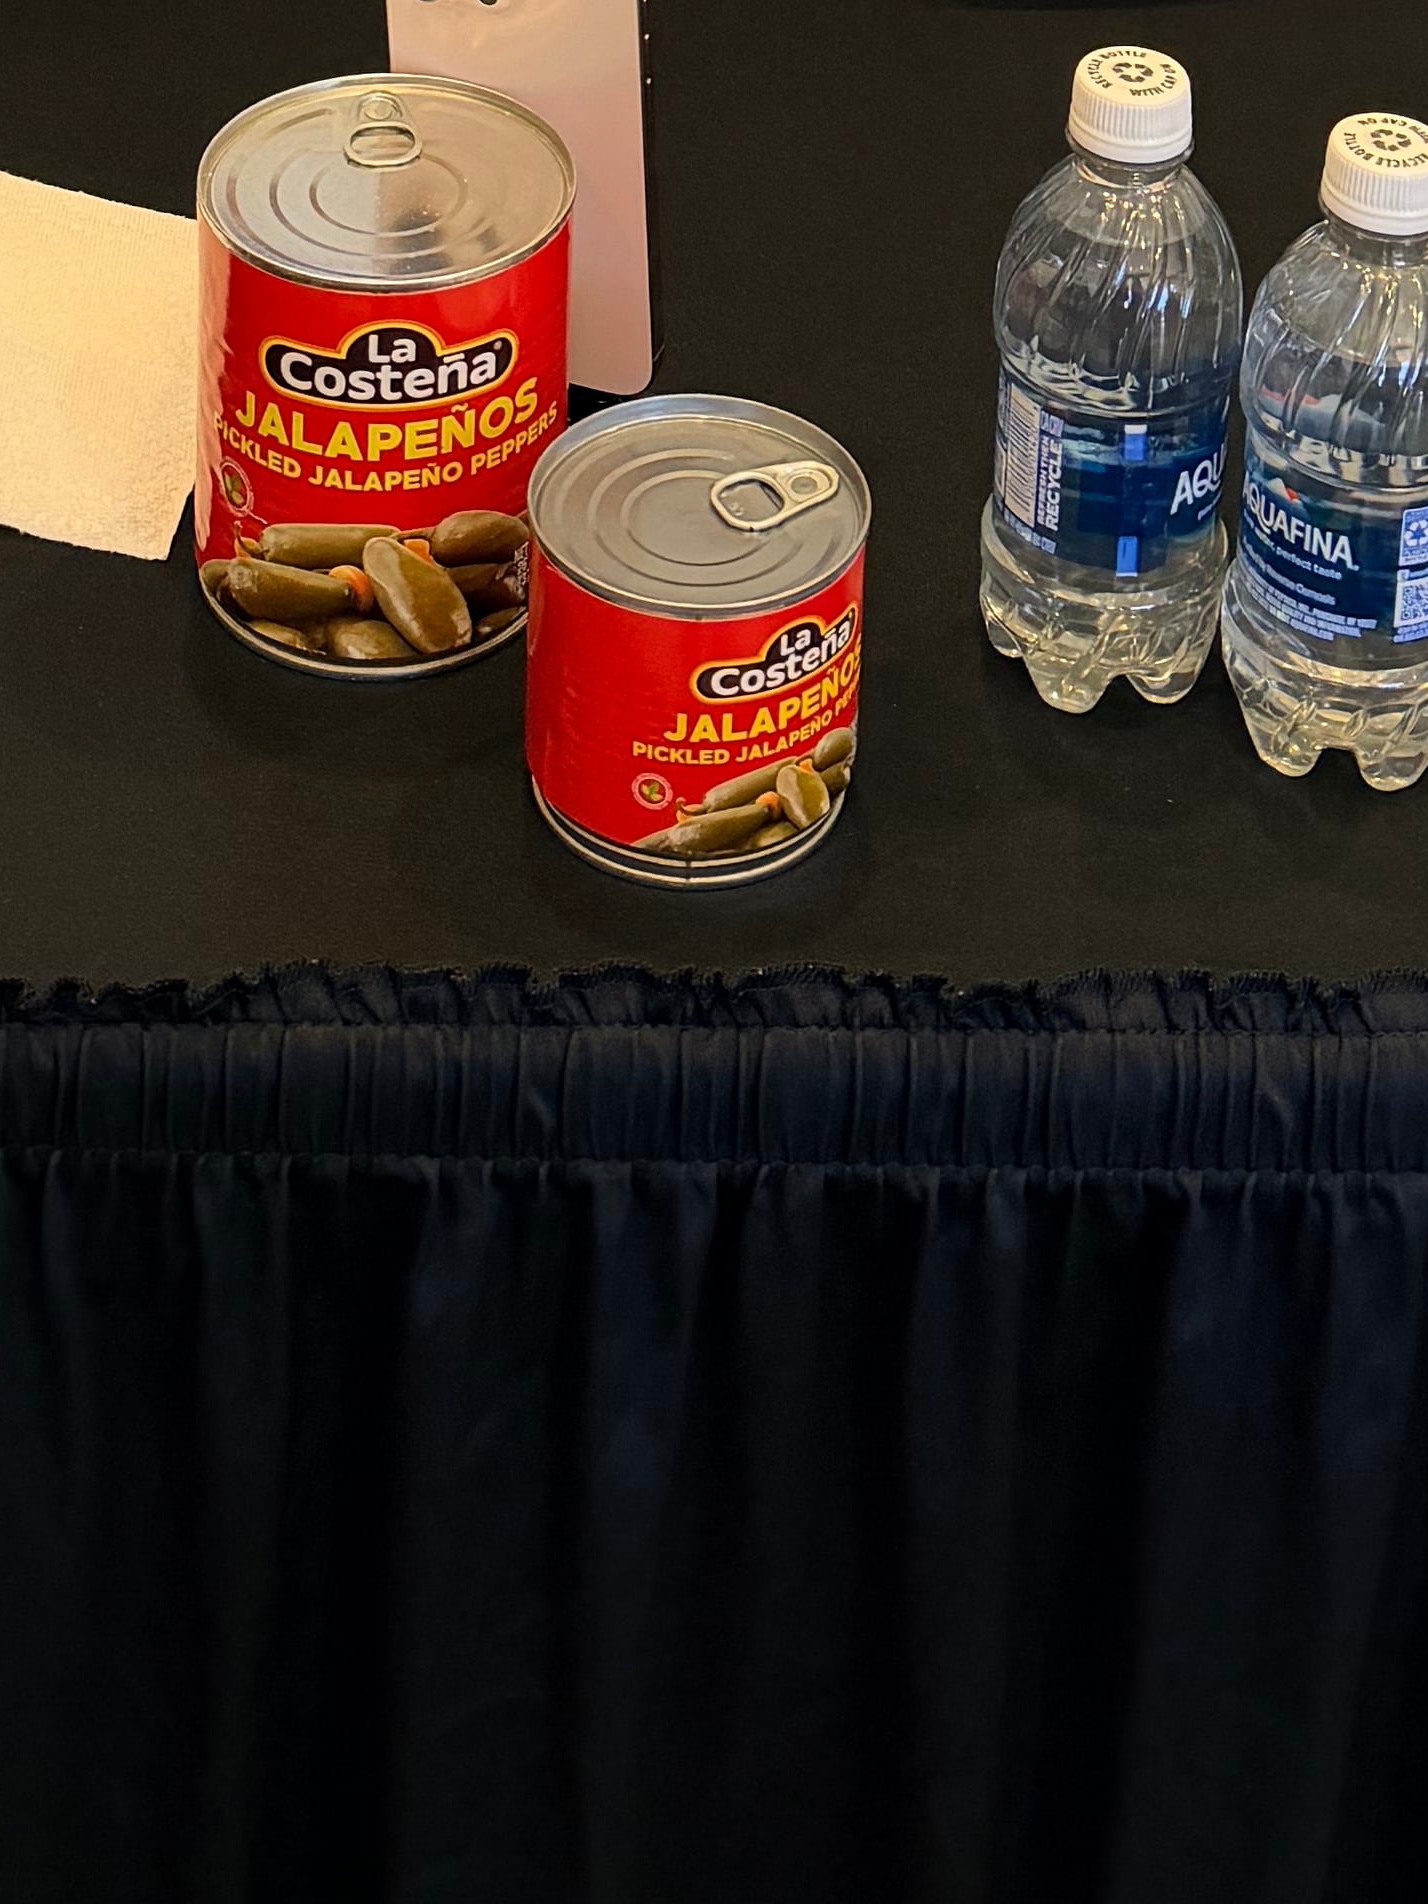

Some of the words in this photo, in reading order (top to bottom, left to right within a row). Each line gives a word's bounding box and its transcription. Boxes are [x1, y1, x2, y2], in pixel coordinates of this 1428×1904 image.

[280, 349, 498, 402] Costeña
[368, 334, 417, 364] La
[213, 411, 302, 479] PICKLED
[308, 461, 464, 492] JALAPEÑO
[470, 400, 558, 477] PEPPERS
[235, 376, 539, 463] JALAPEÑOS
[1044, 438, 1063, 532] RECYCLE
[710, 619, 851, 696] Costeña
[779, 628, 812, 657] La
[632, 740, 730, 766] PICKLED
[735, 709, 832, 763] JALAPEÑO
